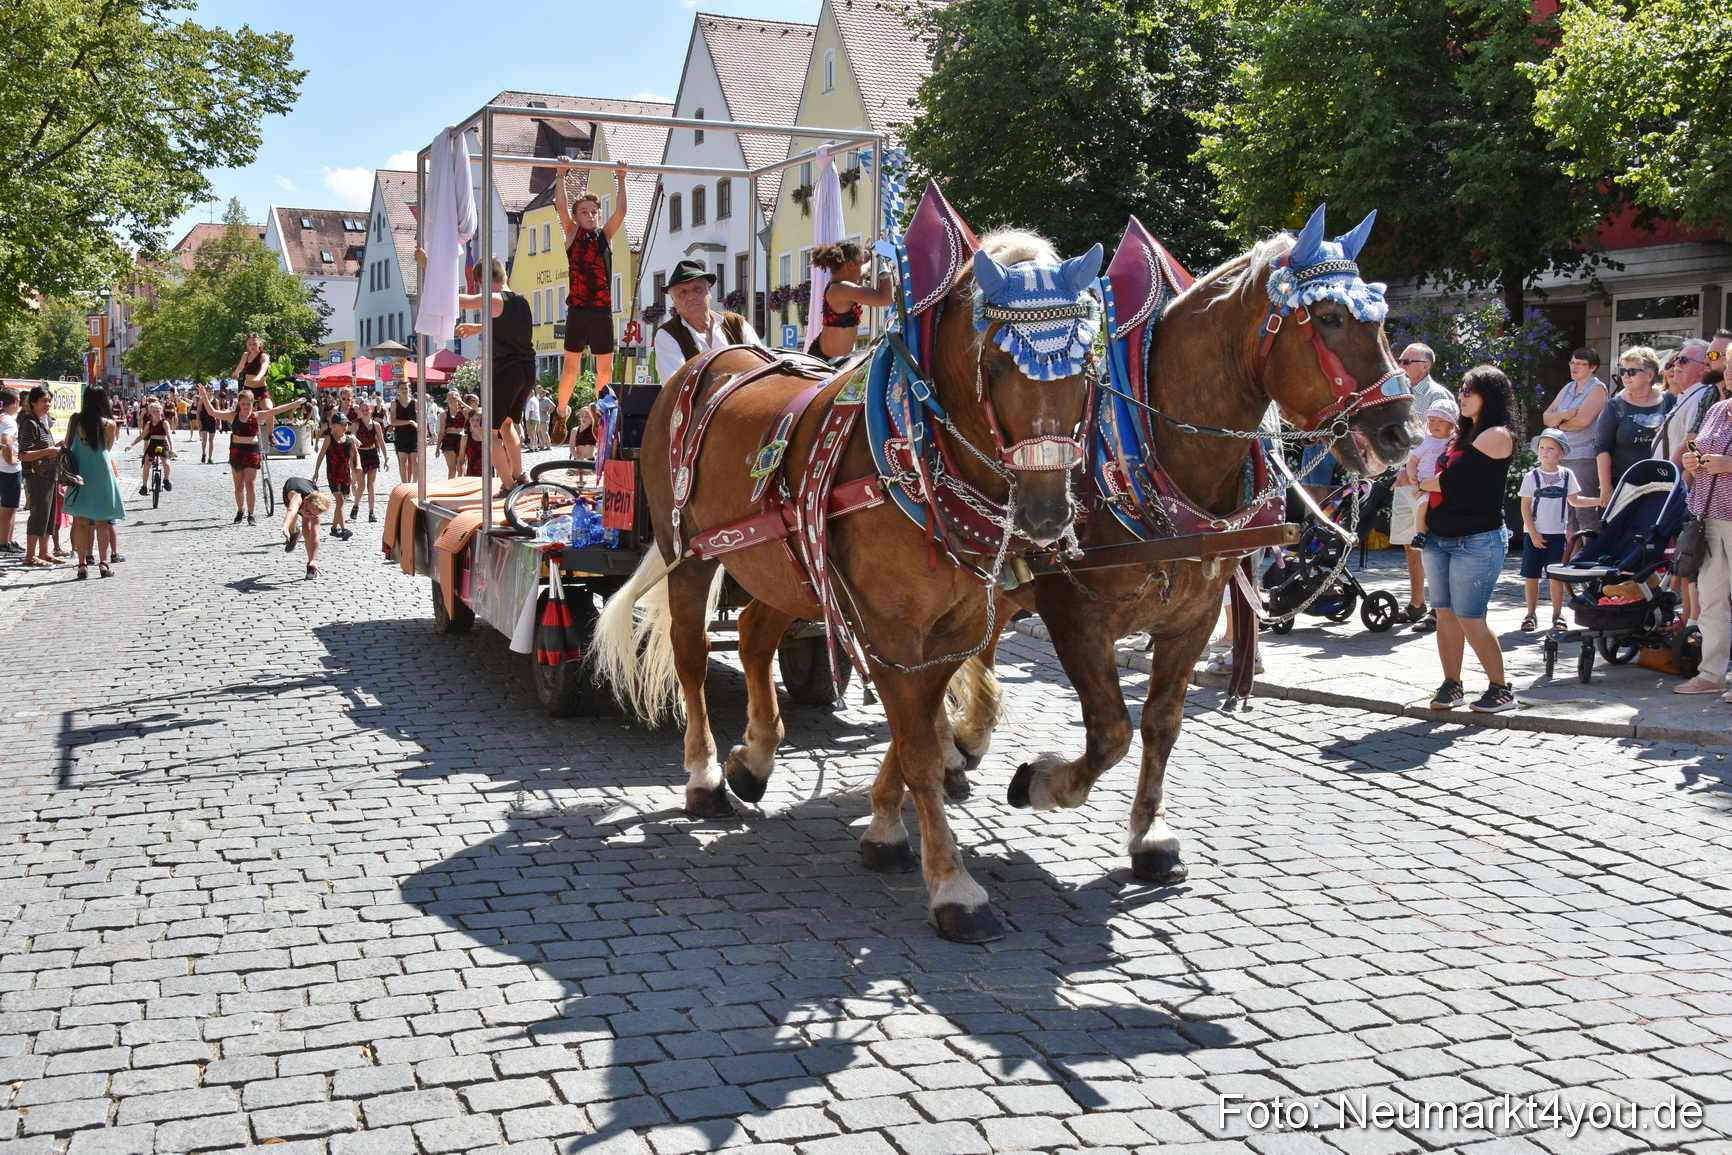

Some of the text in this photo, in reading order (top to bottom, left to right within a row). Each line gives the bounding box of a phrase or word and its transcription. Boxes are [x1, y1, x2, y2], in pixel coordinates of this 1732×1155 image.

[537, 270, 552, 285] HOTEL
[786, 328, 794, 345] P
[536, 340, 557, 350] Restaurant
